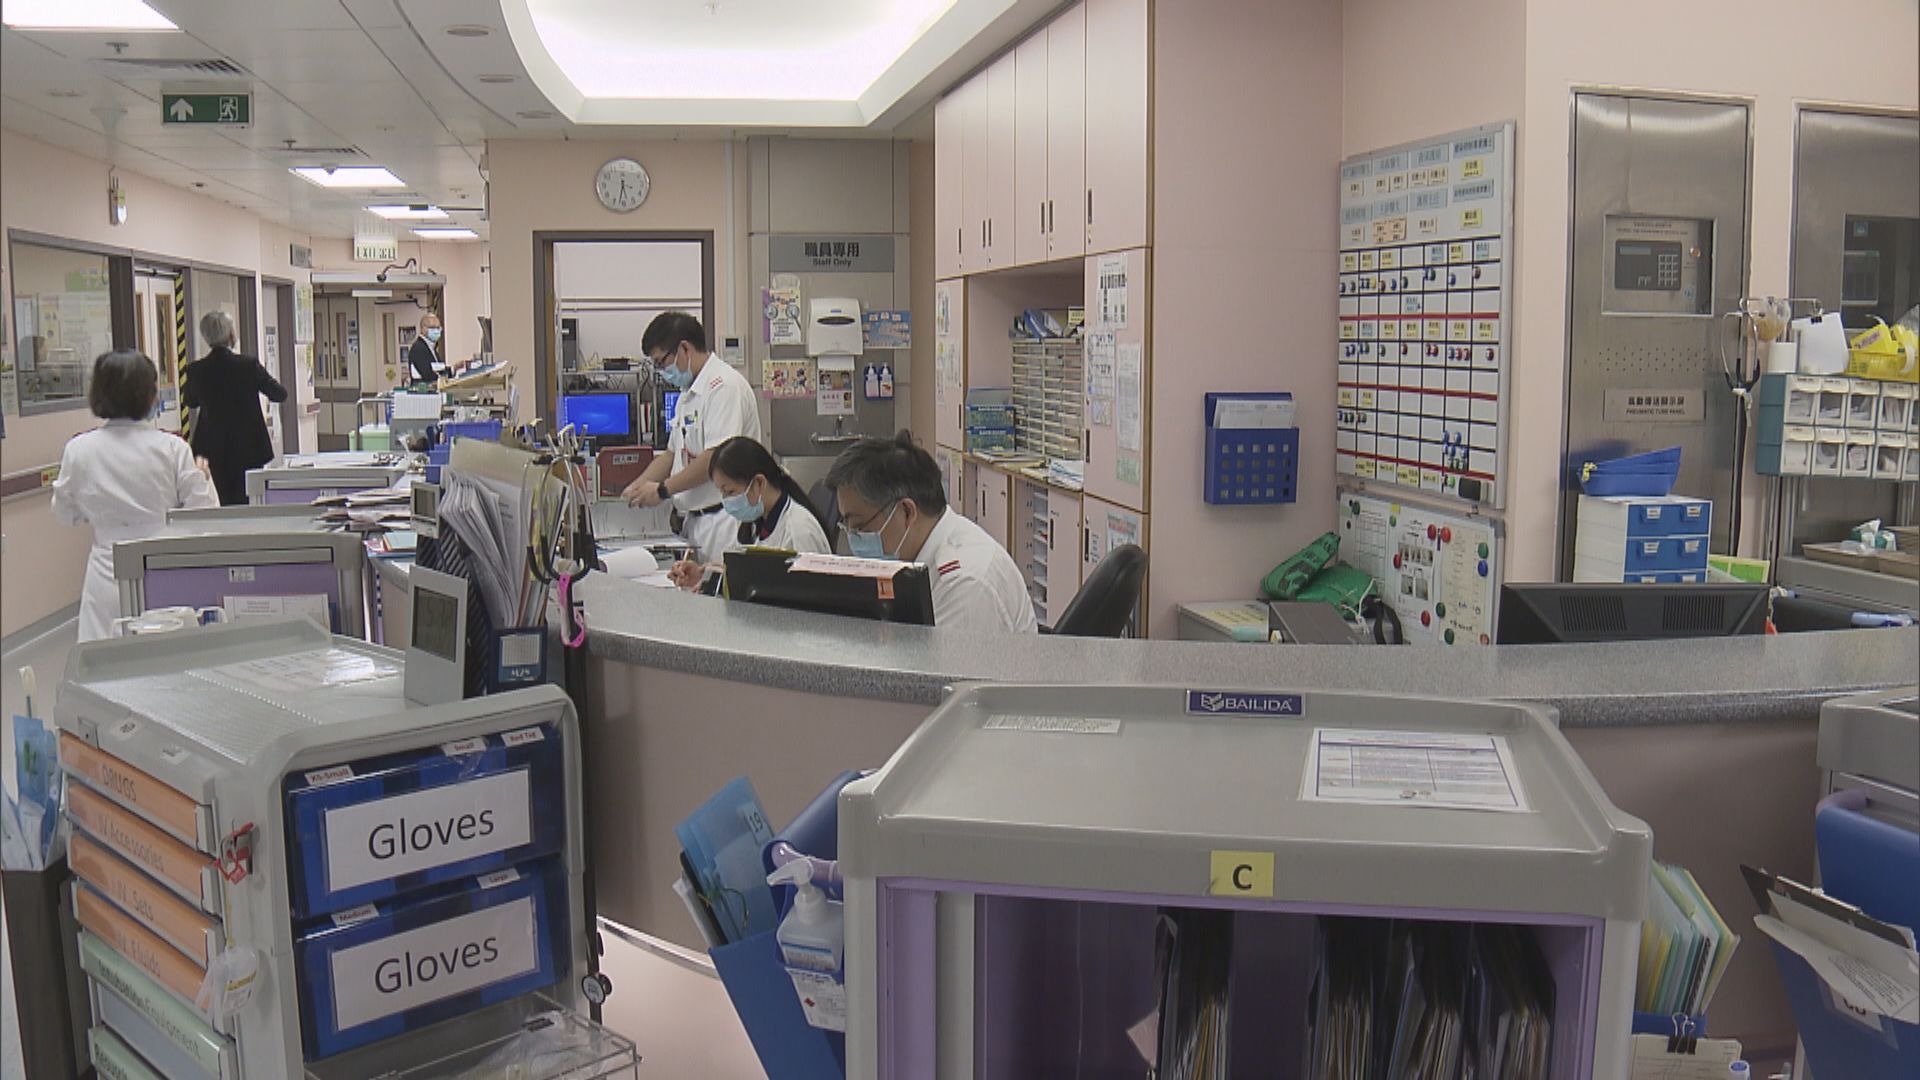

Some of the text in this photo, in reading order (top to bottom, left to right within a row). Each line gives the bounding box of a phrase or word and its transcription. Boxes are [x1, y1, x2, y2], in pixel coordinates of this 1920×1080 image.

[804, 241, 860, 257] 職員專用
[812, 257, 852, 268] Staff Only
[1225, 697, 1293, 712] BAILIDA
[102, 763, 137, 802] DRUGS
[368, 809, 495, 861] Gloves
[1232, 864, 1253, 890] C
[375, 936, 499, 993] Gloves
